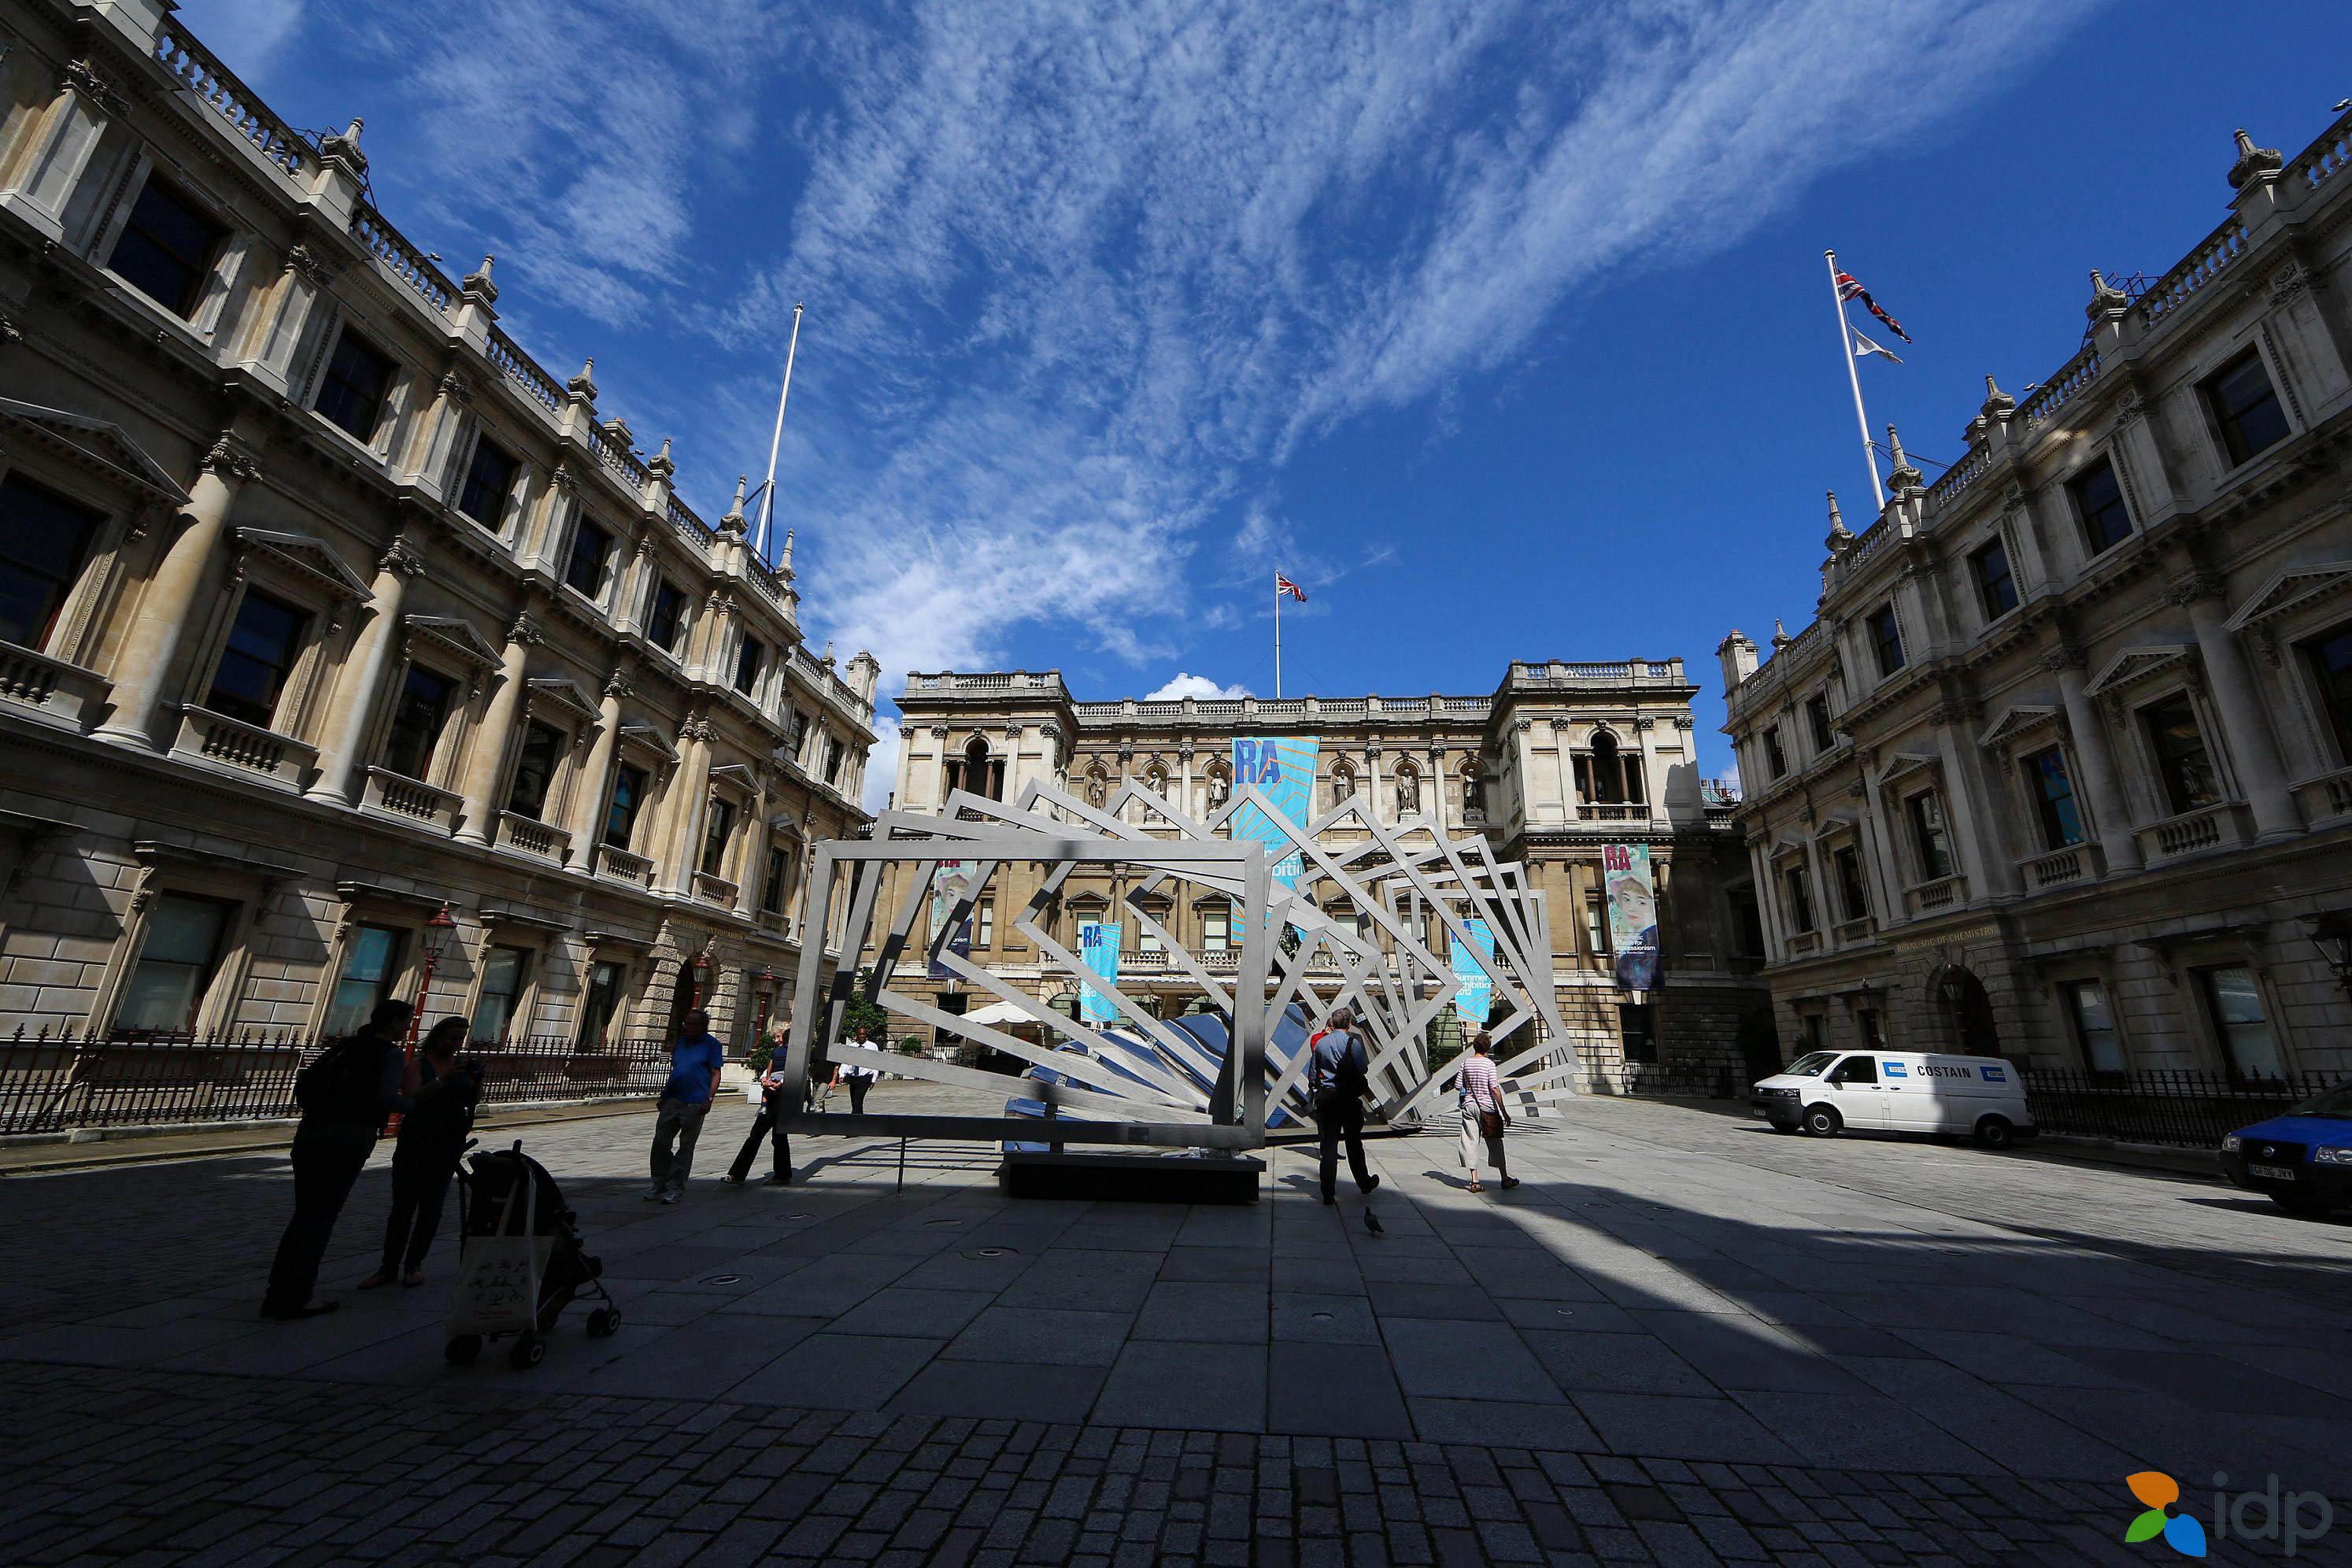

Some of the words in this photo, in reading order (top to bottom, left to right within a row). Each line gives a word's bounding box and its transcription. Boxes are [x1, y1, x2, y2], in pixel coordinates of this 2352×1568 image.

[1236, 741, 1281, 783] RA
[1604, 846, 1632, 870] RA
[671, 918, 697, 929] SOCIETY
[1084, 926, 1102, 947] RA
[1897, 941, 1921, 952] ROYAL
[1950, 925, 1996, 942] CHEMISTRY
[1917, 1065, 1971, 1078] COSTAIN
